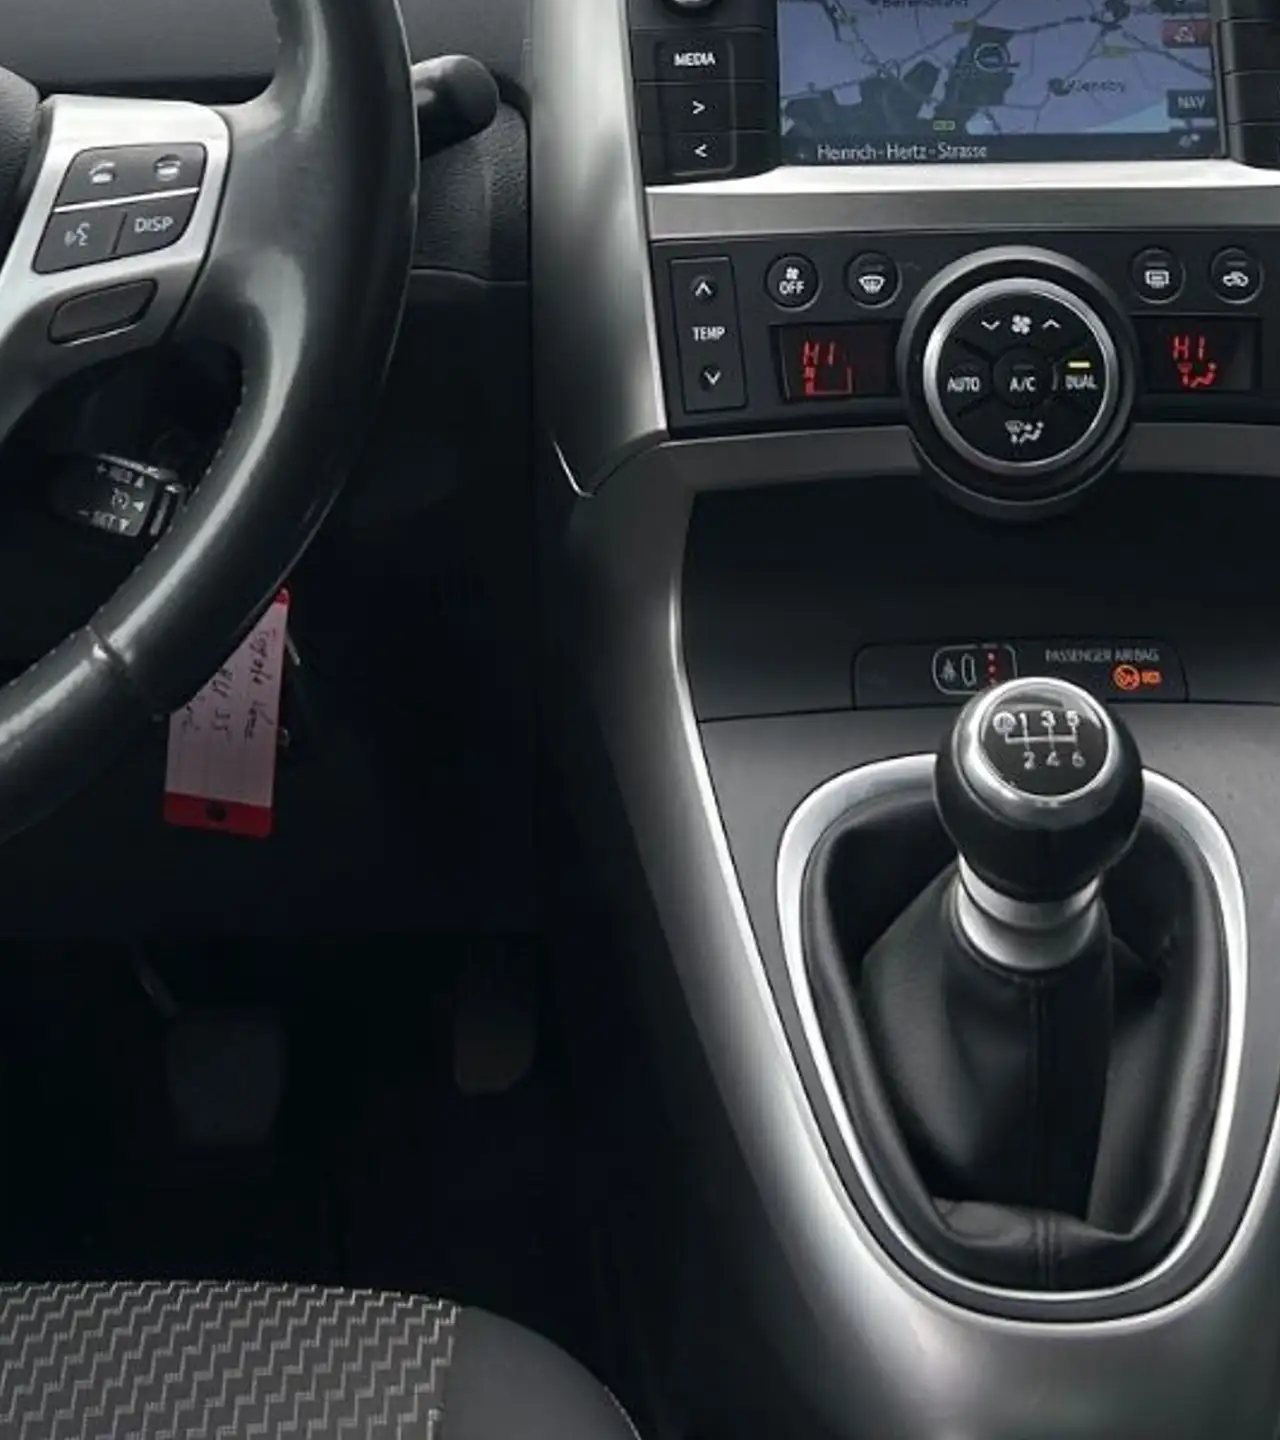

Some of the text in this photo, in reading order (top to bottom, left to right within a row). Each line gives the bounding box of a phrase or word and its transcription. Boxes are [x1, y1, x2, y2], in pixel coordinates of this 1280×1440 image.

[673, 52, 716, 67] MEDIA
[134, 215, 174, 234] DISP
[778, 281, 805, 296] OFF
[692, 325, 726, 341] TEMP
[947, 375, 980, 393] AUTO
[1009, 376, 1037, 393] A/C
[1064, 374, 1098, 390] DUAL
[1040, 709, 1056, 728] 3
[1023, 750, 1087, 770] 2 4 6
